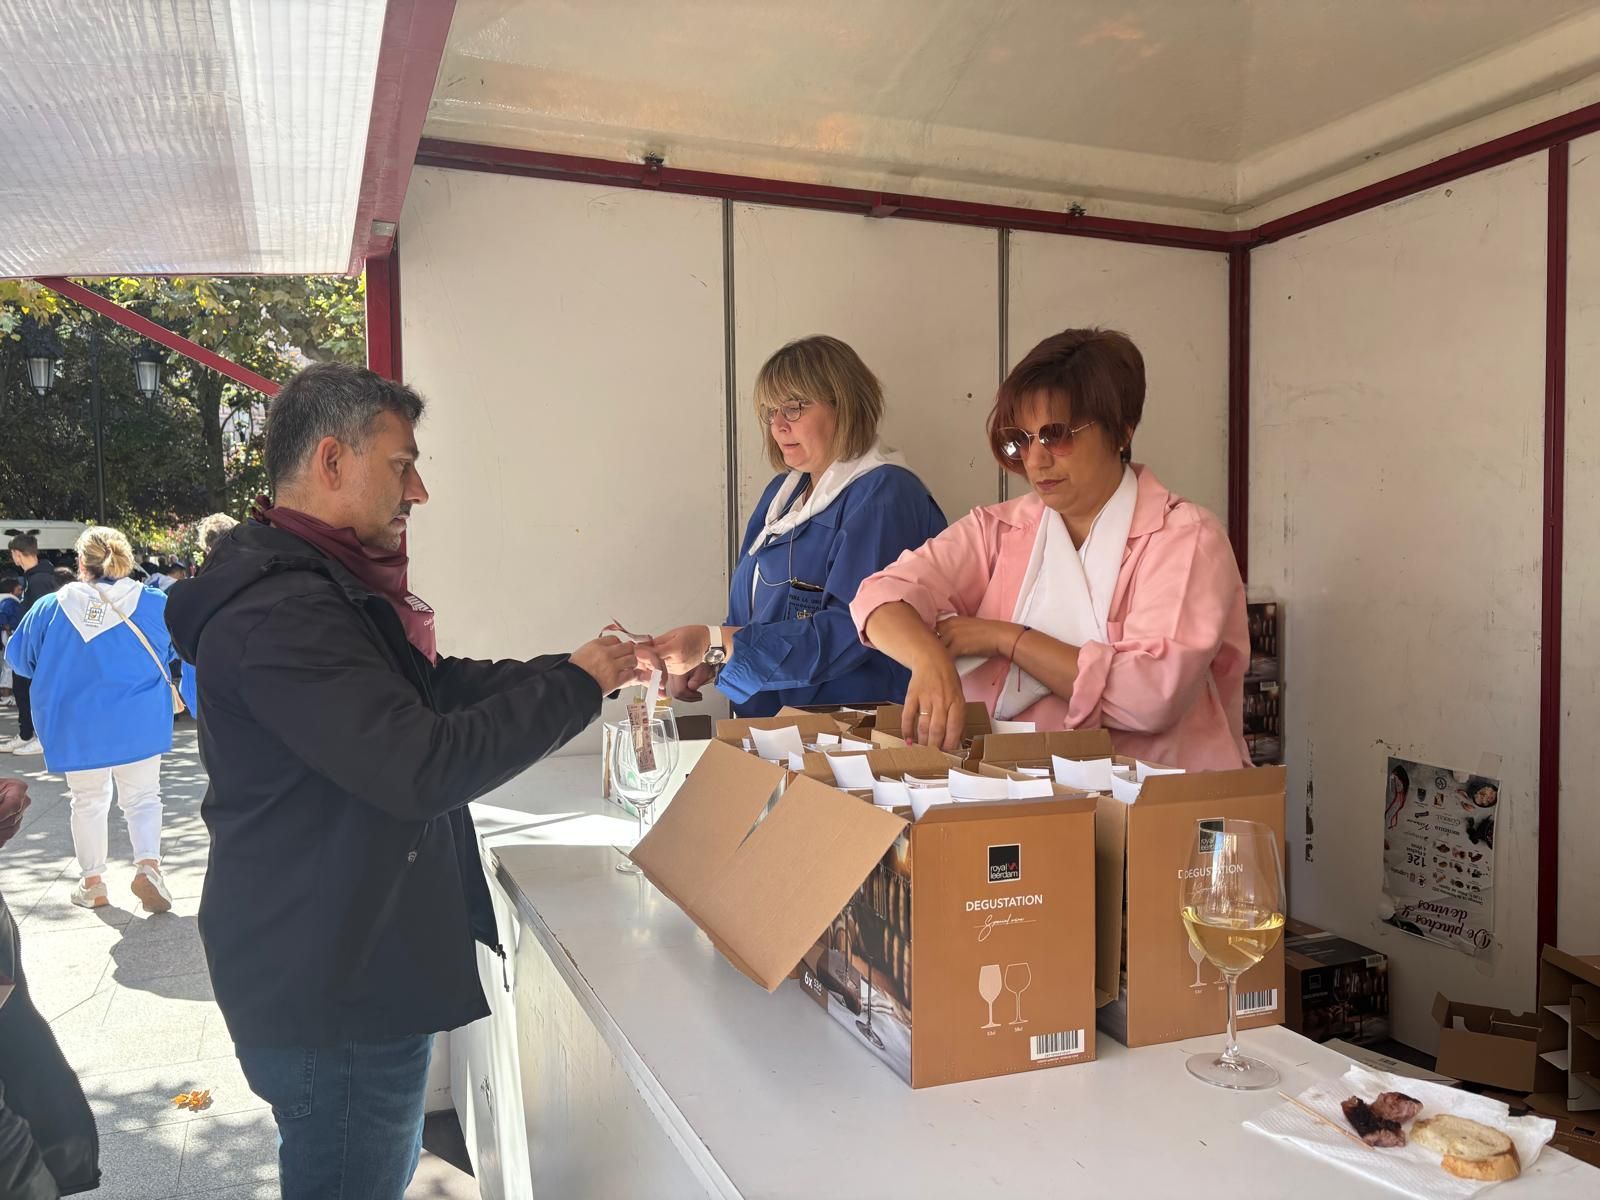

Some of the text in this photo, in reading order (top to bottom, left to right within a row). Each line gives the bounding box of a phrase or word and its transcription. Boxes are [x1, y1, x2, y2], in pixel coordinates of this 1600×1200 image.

[990, 863, 1008, 874] royal
[1407, 853, 1427, 868] 12€
[990, 871, 1018, 880] leerdam
[966, 894, 1043, 912] DEGUSTATION
[1417, 900, 1468, 923] de vinos
[1415, 915, 1465, 938] pinchos
[1466, 929, 1491, 949] De
